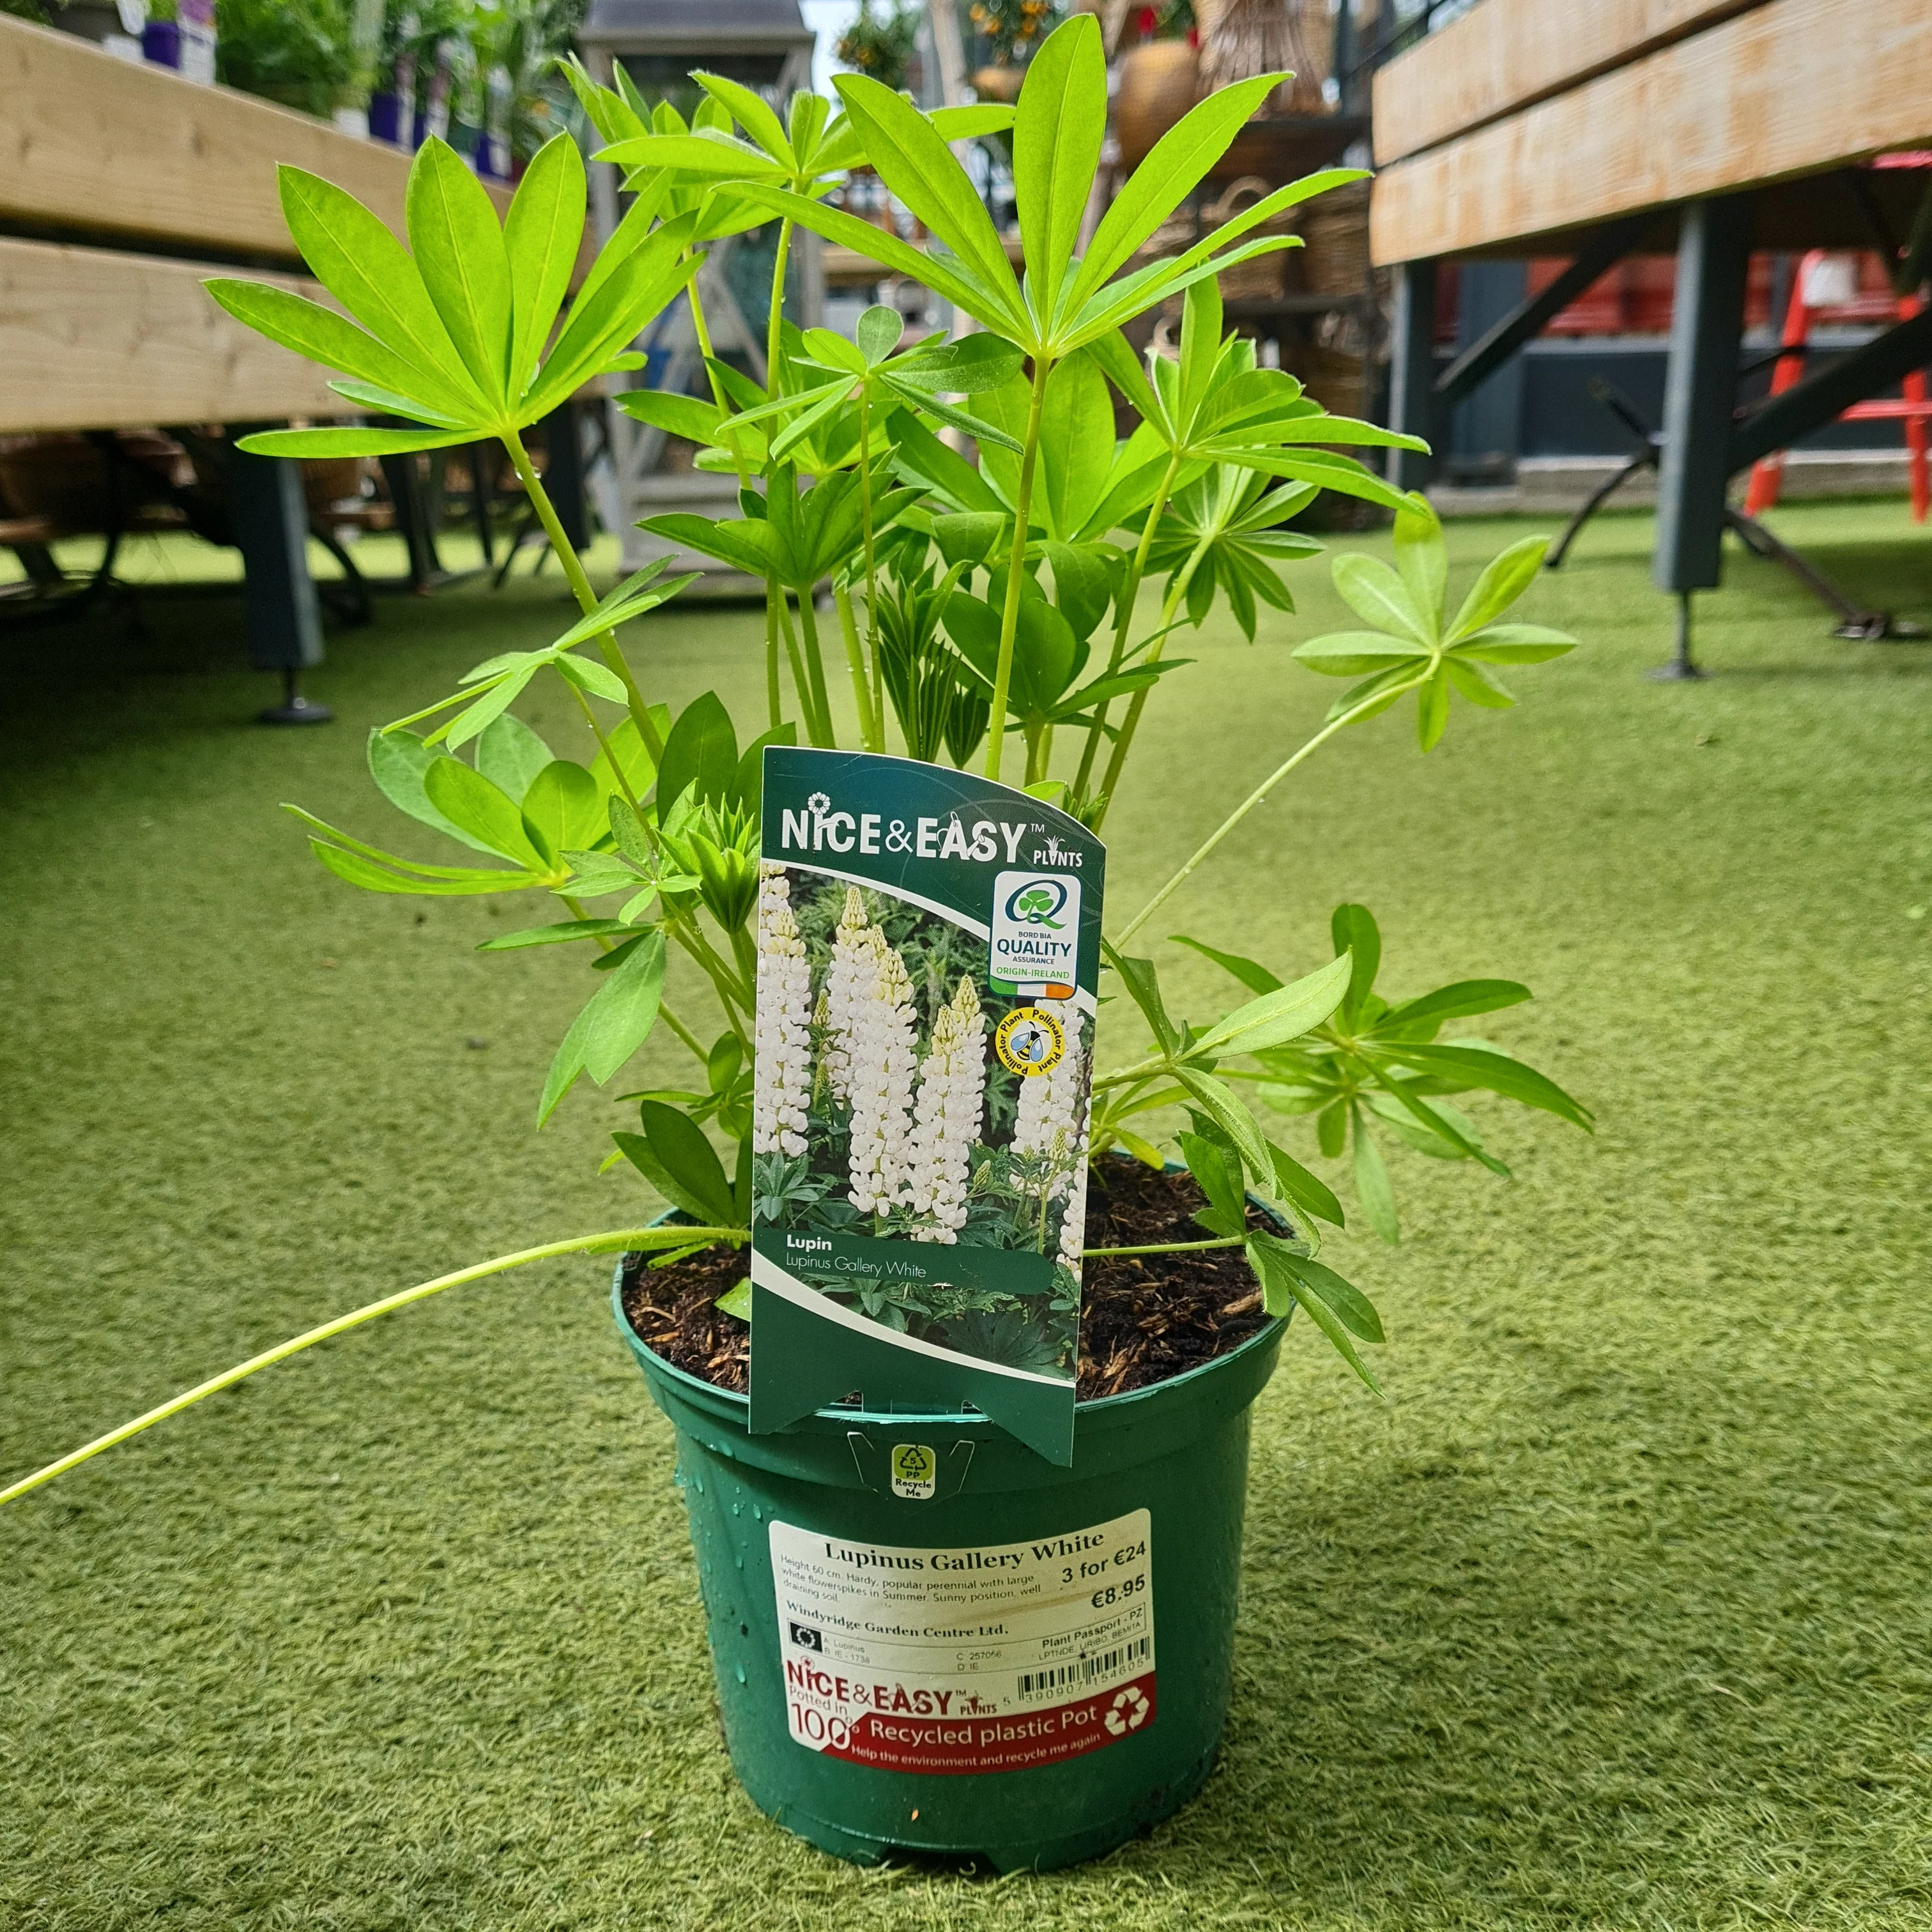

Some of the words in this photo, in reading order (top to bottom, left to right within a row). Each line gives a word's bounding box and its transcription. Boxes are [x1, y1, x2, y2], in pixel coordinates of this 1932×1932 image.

[997, 939, 1072, 957] QUALITY
[1012, 956, 1055, 965] ASSURANCE
[996, 967, 1070, 979] ORIGIN-IRELAND
[1000, 1012, 1023, 1032] Plant
[1032, 1009, 1062, 1050] Pollinator
[999, 1034, 1029, 1075] Pollinator
[1038, 1052, 1062, 1073] Plant
[786, 1234, 832, 1252] Lupin
[786, 1252, 831, 1271] Lupinus
[834, 1256, 882, 1278] Gallery
[886, 1261, 926, 1278] White
[896, 1478, 931, 1489] Recycle
[906, 1489, 921, 1497] Me
[824, 1542, 924, 1570] Lupinus
[930, 1552, 1024, 1571] Gallery
[1031, 1534, 1105, 1561] White
[1061, 1567, 1073, 1584] 3
[1080, 1558, 1109, 1579] for
[1114, 1540, 1146, 1566] €24
[780, 1554, 810, 1571] Height
[882, 1579, 923, 1590] popular
[927, 1581, 977, 1591] perennial
[980, 1577, 1004, 1588] with
[1007, 1574, 1034, 1587] large
[781, 1567, 806, 1582] white
[870, 1588, 879, 1598] in
[933, 1593, 967, 1604] Sunny
[1020, 1584, 1041, 1596] well
[783, 1579, 820, 1600] draining
[1091, 1574, 1146, 1609] €8.95
[786, 1600, 861, 1630] Windyridge
[864, 1622, 919, 1637] Garden
[923, 1627, 974, 1638] Centre
[979, 1624, 1009, 1636] Ltd.
[1041, 1634, 1071, 1648] Plant
[1074, 1618, 1121, 1640] Passport
[1130, 1607, 1143, 1621] PZ
[789, 1685, 831, 1712] Potted
[834, 1703, 848, 1715] in
[870, 1719, 972, 1748] Recycled
[980, 1717, 1055, 1748] plastic
[1061, 1706, 1098, 1729] Pot
[851, 1744, 877, 1761] Help
[880, 1751, 899, 1763] the
[901, 1753, 977, 1767] environment
[980, 1753, 1003, 1766] and
[1006, 1747, 1047, 1763] recycle
[1050, 1744, 1068, 1754] me
[1070, 1733, 1101, 1751] again
